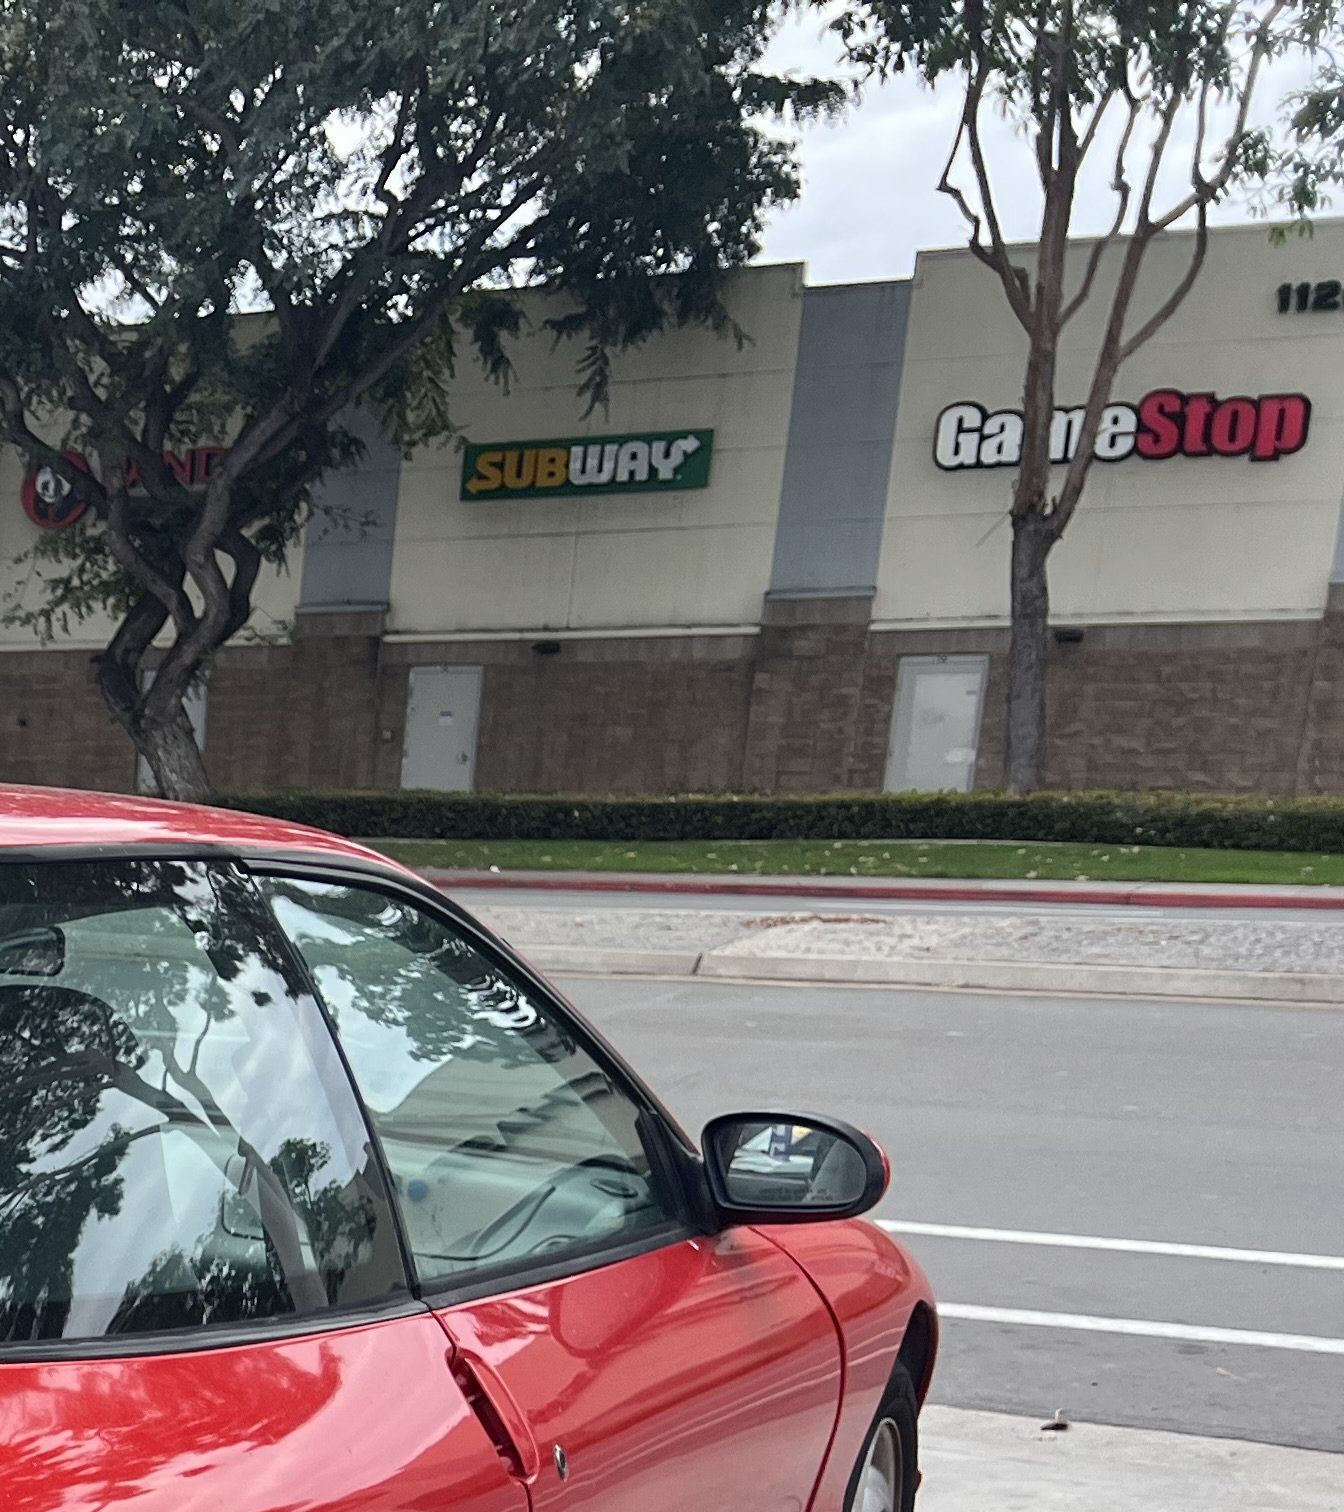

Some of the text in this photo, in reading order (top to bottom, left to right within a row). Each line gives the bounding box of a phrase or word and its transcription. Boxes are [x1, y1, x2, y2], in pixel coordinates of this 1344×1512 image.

[1276, 280, 1344, 313] 112
[936, 389, 1310, 469] GameStop
[465, 434, 701, 494] SUBWAY
